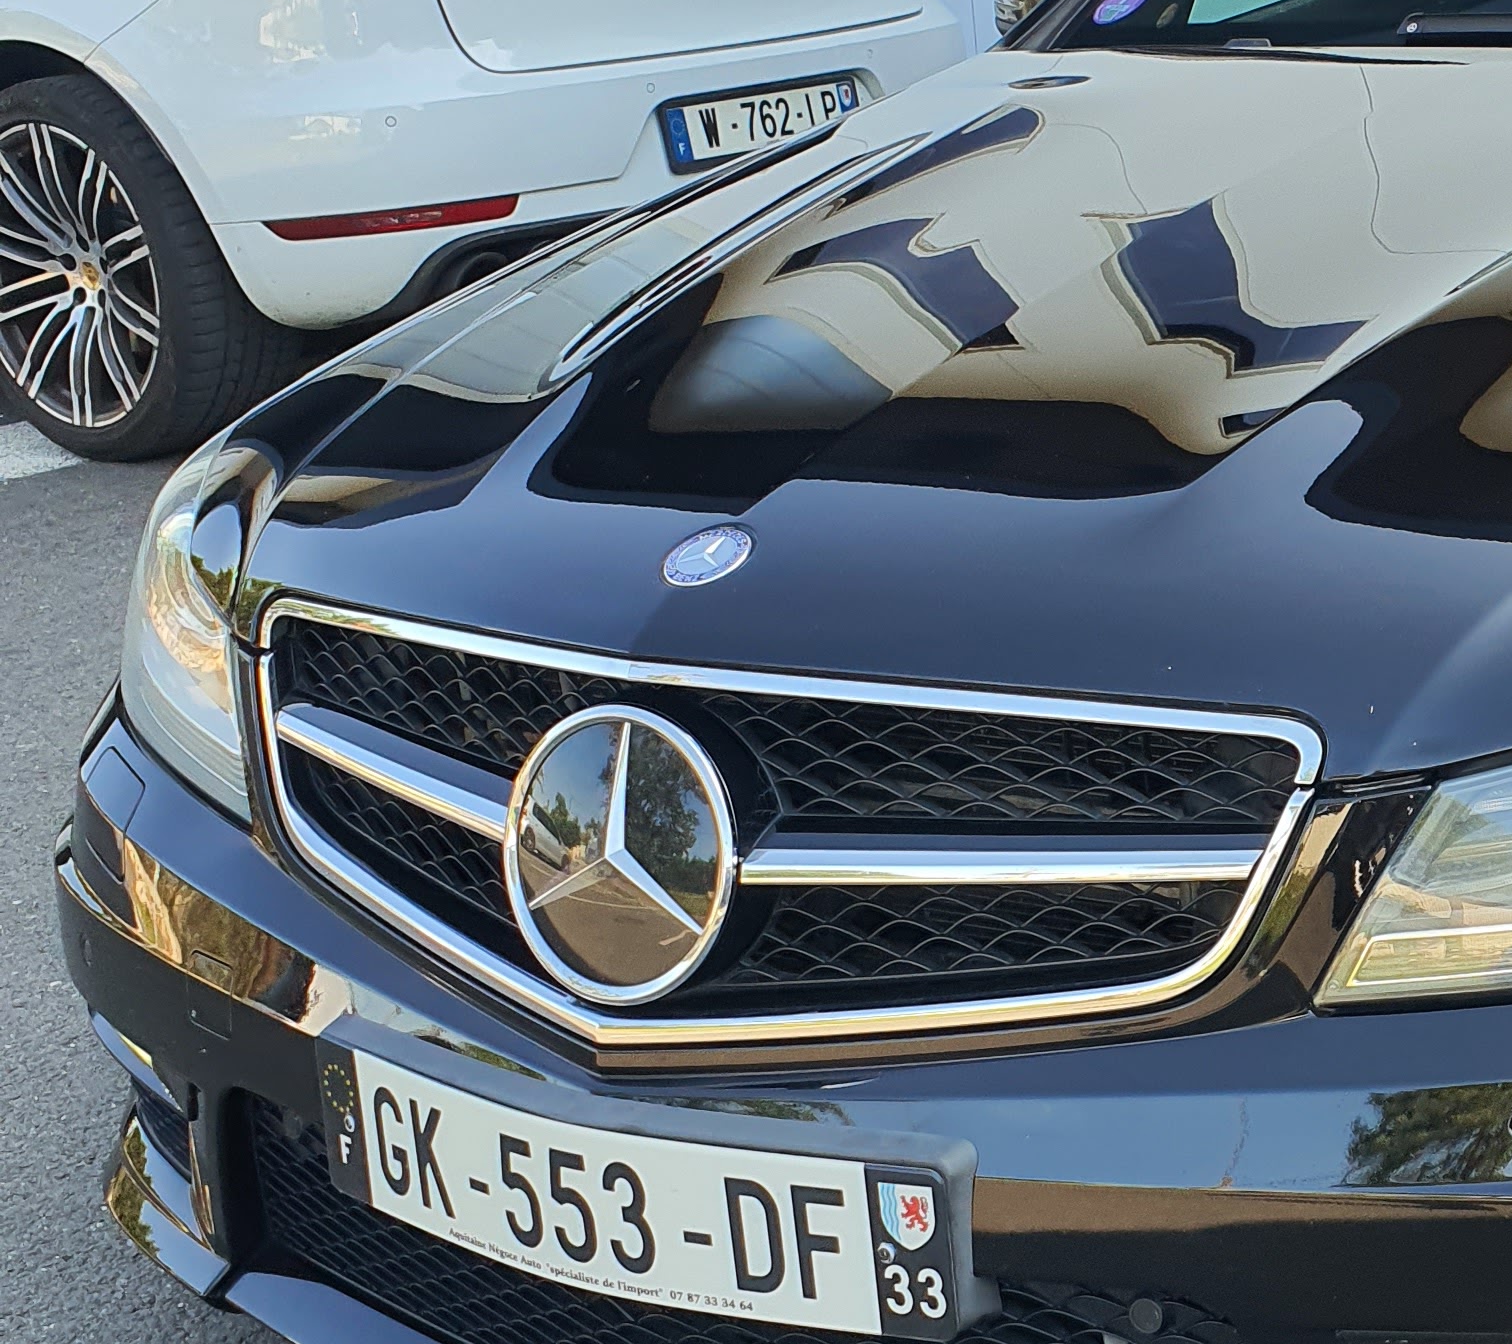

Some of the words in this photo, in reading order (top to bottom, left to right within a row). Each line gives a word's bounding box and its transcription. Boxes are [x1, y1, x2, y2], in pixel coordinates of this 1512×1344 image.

[678, 142, 686, 156] F
[339, 1133, 352, 1165] F
[374, 1086, 845, 1302] GK-553-DF
[520, 1255, 542, 1270] Auto
[602, 1277, 615, 1289] de
[669, 1290, 684, 1301] 07
[687, 1292, 701, 1305] 87
[704, 1295, 719, 1307] 33
[721, 1298, 736, 1309] 34
[739, 1300, 754, 1311] 64
[883, 1264, 948, 1320] 33
